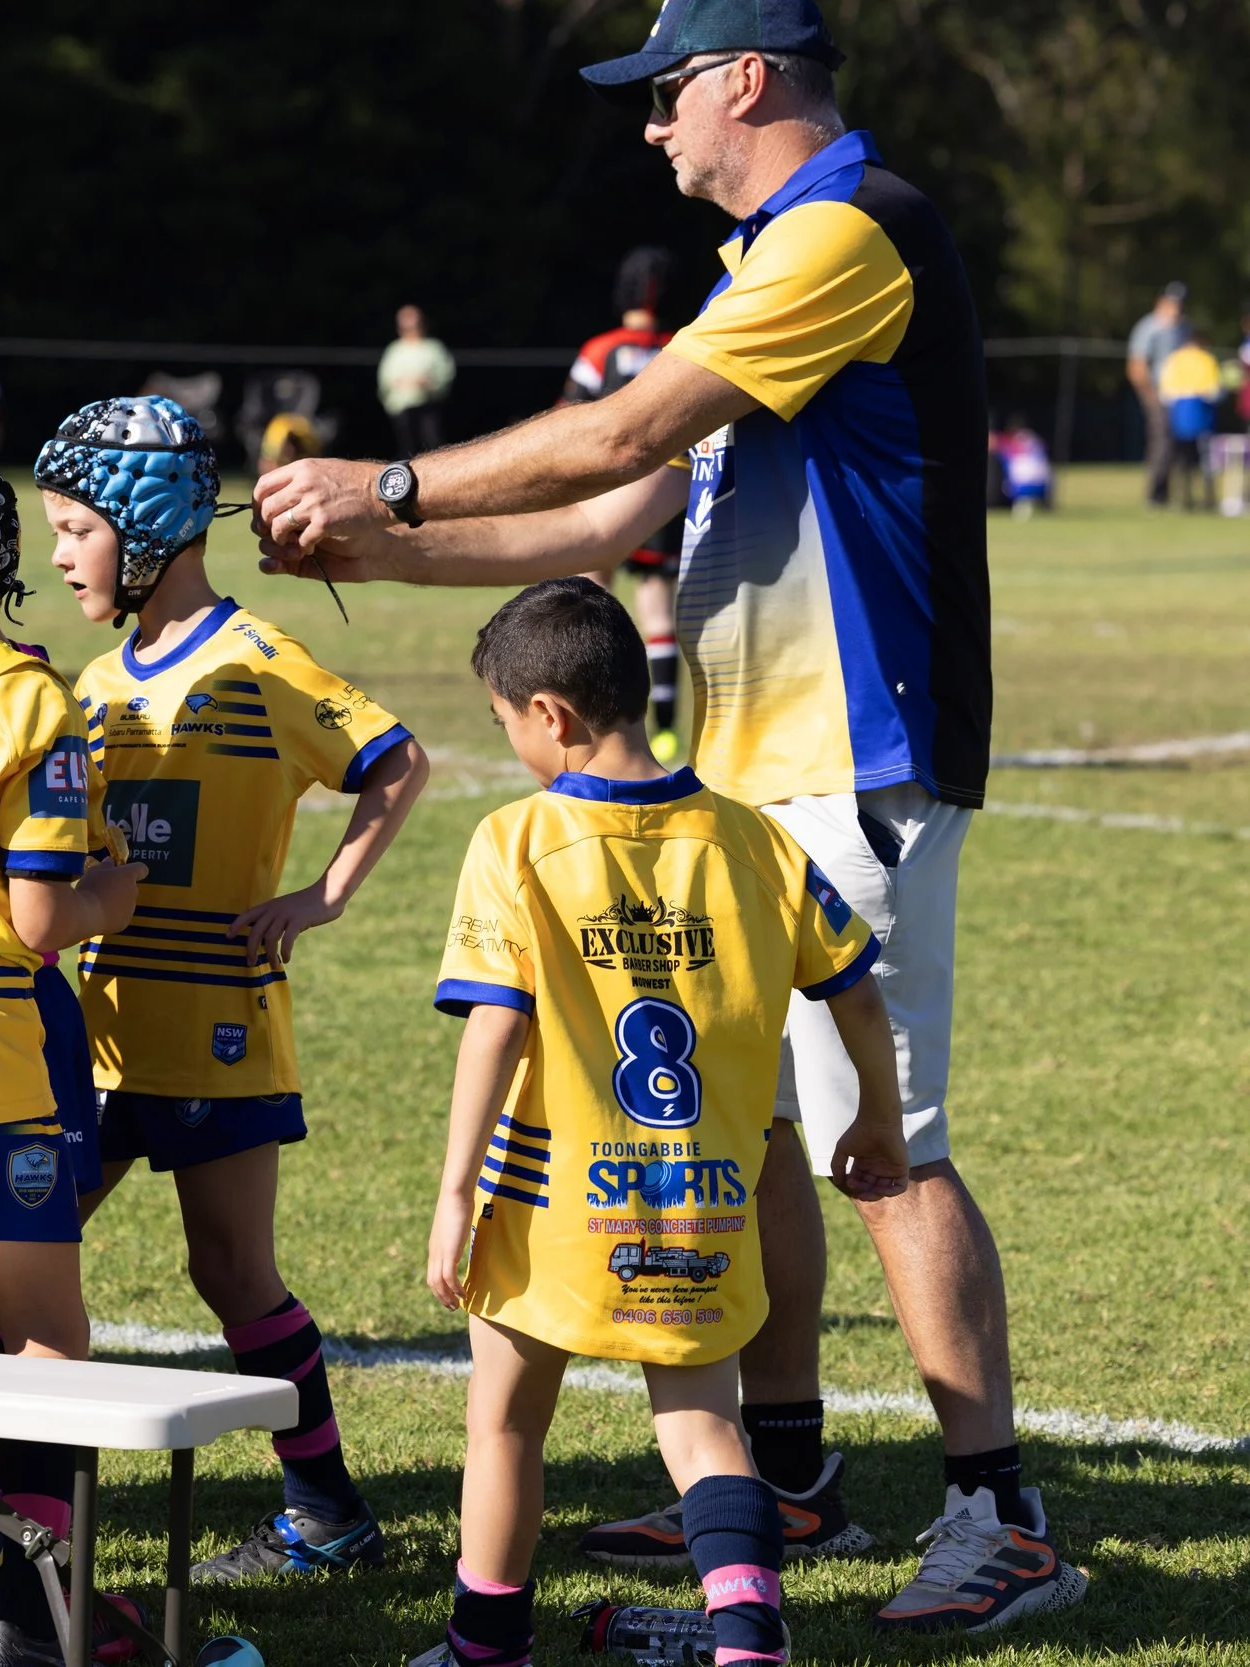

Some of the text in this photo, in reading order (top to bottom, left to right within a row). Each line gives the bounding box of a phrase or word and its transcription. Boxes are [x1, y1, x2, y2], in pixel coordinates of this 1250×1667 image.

[171, 723, 225, 736] HAWKS
[59, 795, 78, 803] CAFE
[451, 915, 498, 933] URBAN
[580, 927, 715, 957] EXCLUSIVE
[622, 957, 680, 972] BARBER SHOP
[631, 976, 670, 989] NORWEST
[217, 1027, 244, 1038] NSW
[612, 995, 702, 1130] 8
[590, 1142, 700, 1157] TOONGABBIE
[15, 1174, 53, 1183] HAWKS
[586, 1159, 747, 1210] SPORTS
[588, 1216, 746, 1234] ST MARY'S CONCRETE PUMPING
[621, 1284, 648, 1294] You've
[672, 1284, 689, 1293] been
[689, 1284, 718, 1294] pumped
[639, 1295, 655, 1303] like
[656, 1295, 671, 1303] this
[673, 1295, 695, 1305] before
[612, 1308, 724, 1324] 0406 650 500
